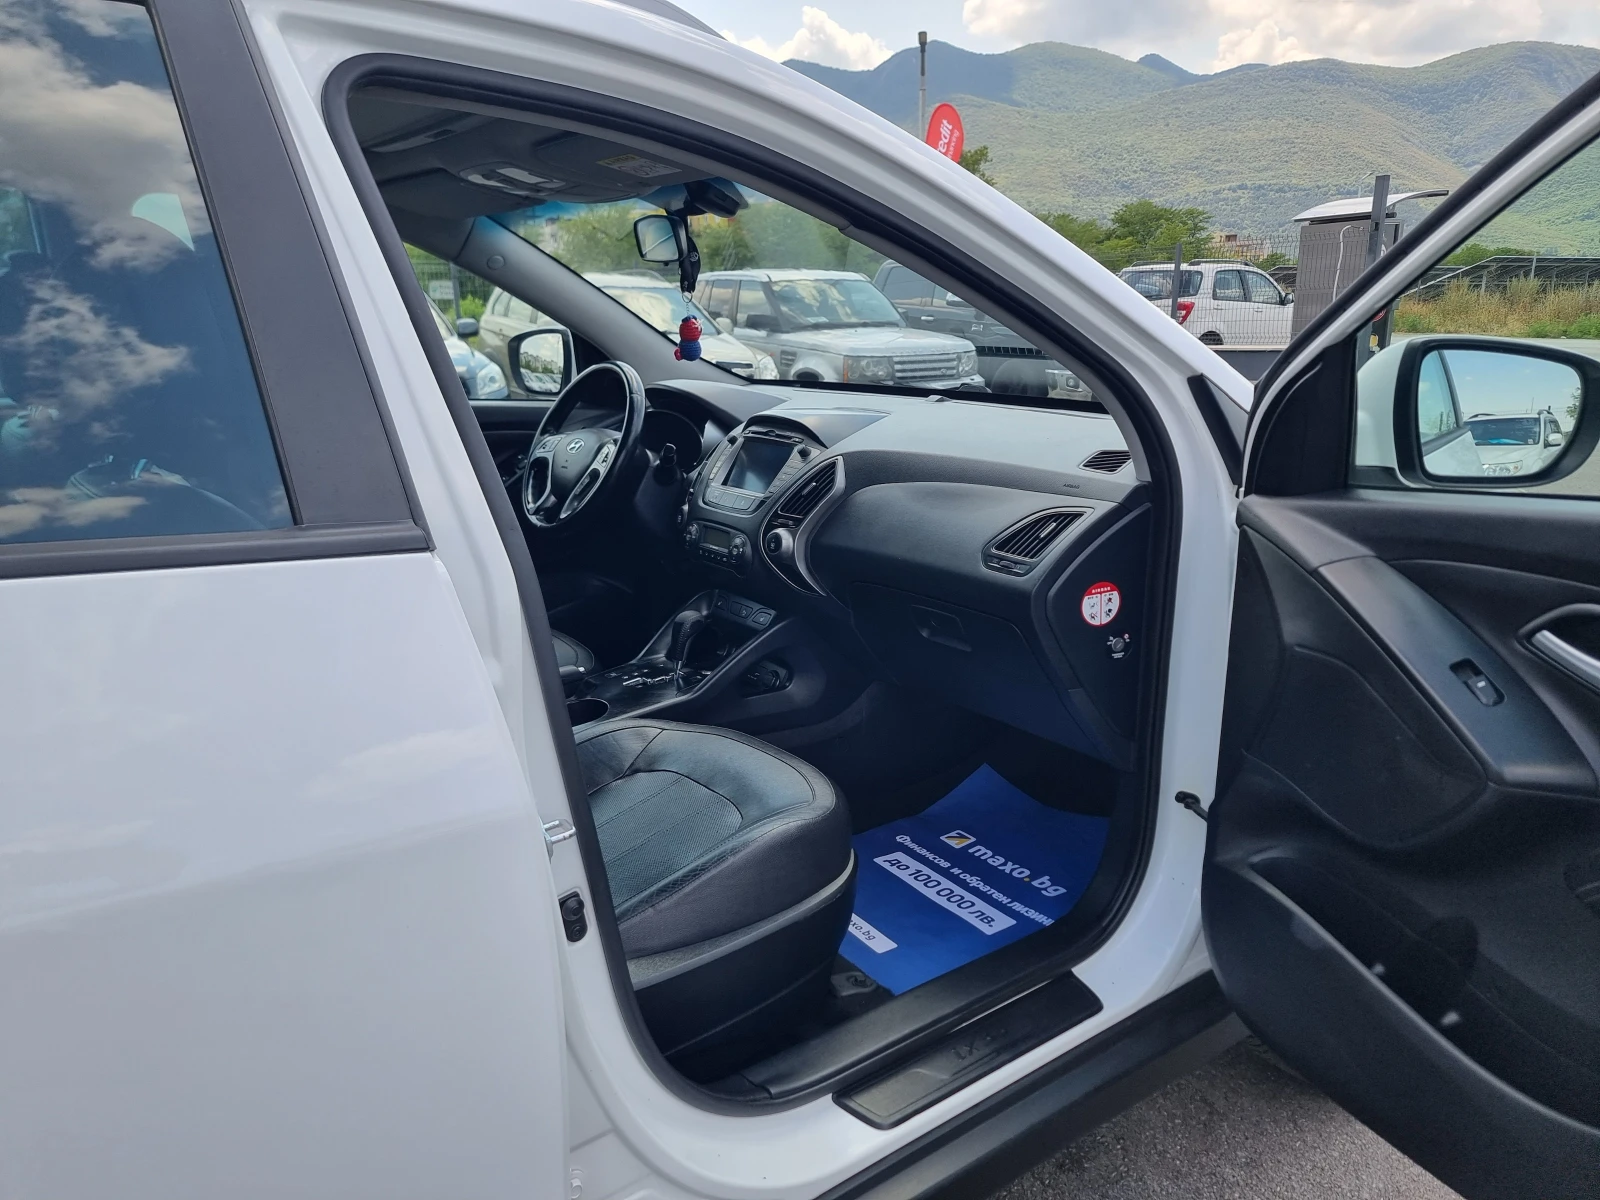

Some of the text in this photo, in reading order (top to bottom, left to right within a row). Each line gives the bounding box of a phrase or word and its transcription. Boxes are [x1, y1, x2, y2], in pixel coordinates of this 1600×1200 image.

[896, 834, 1055, 927] Финансов и обратен лизин
[908, 868, 942, 889] 100
[935, 887, 976, 910] 000
[967, 910, 996, 928] лв.
[968, 845, 1067, 897] maxo.bg
